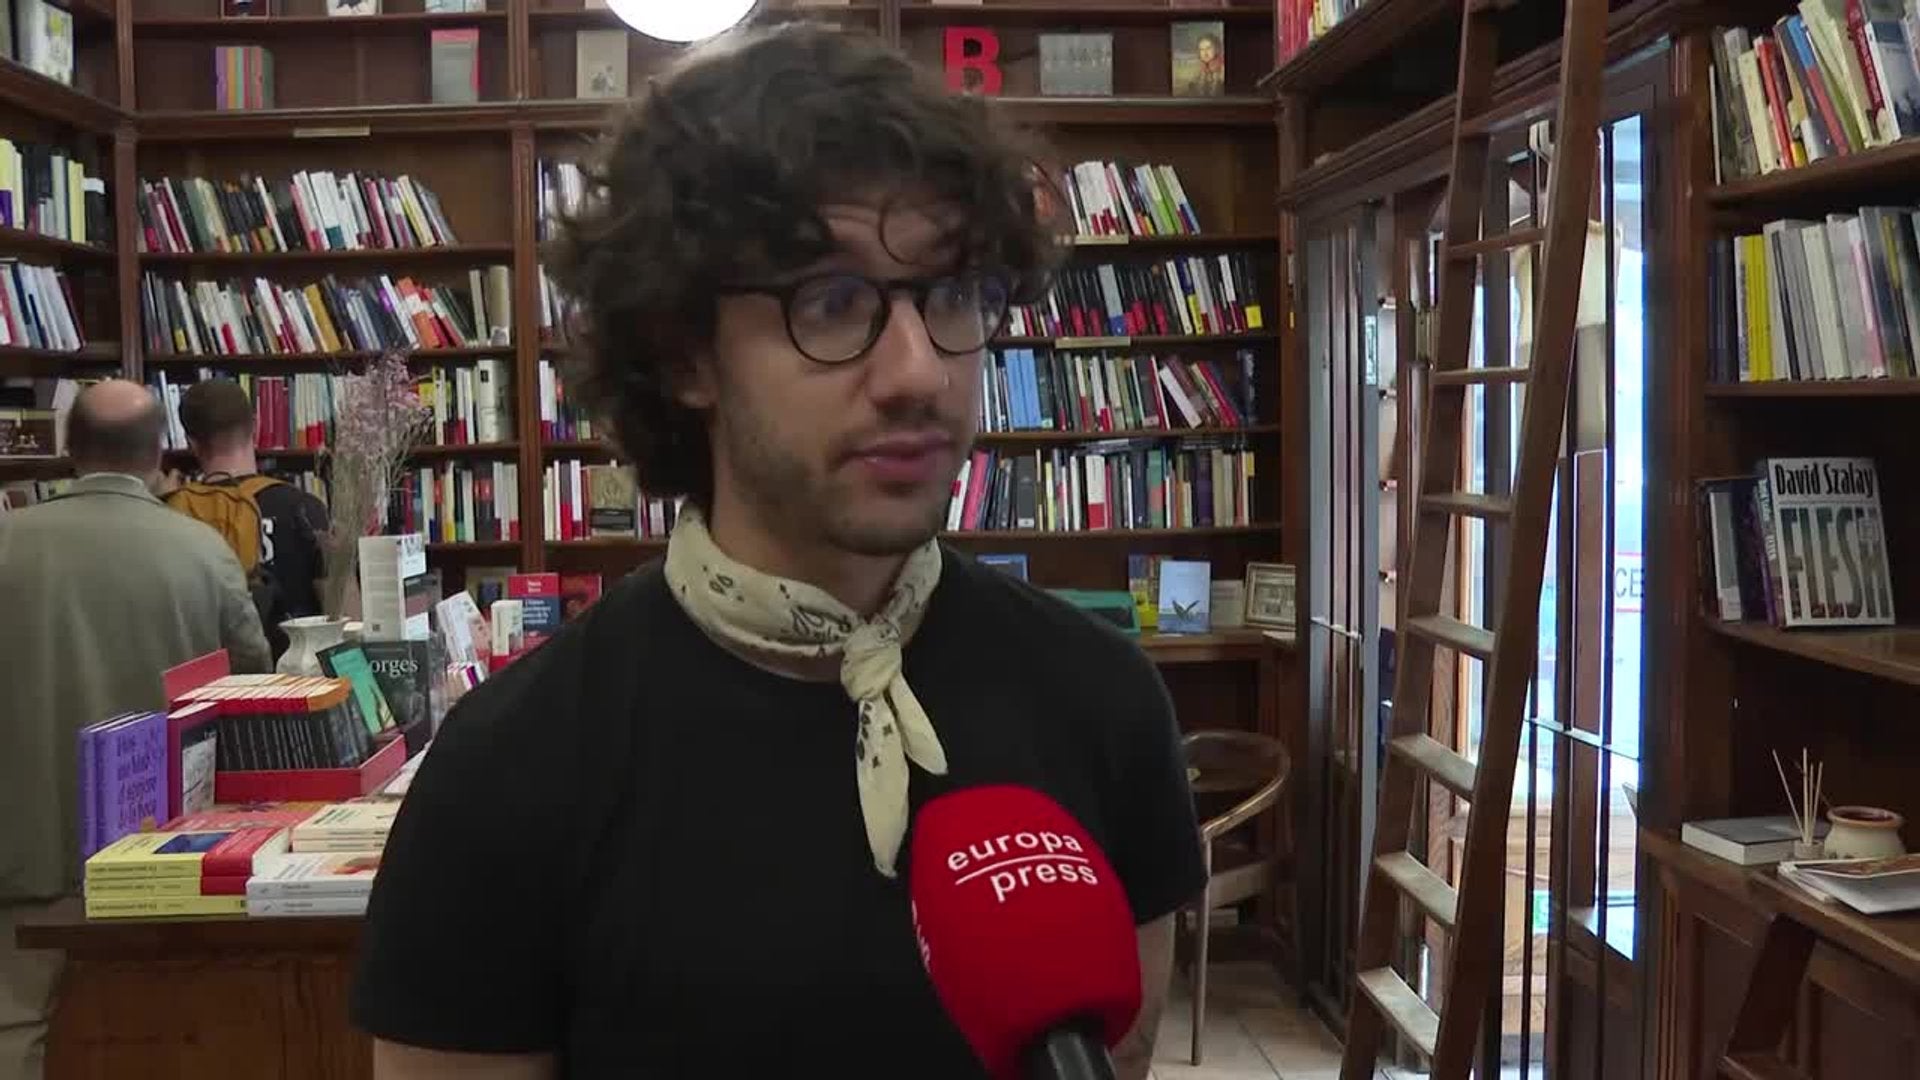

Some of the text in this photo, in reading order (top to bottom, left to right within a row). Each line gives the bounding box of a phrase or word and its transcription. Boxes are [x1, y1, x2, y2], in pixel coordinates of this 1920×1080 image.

[944, 26, 1003, 95] B
[1775, 462, 1874, 498] David Szalay
[1781, 507, 1891, 619] FLESH
[370, 658, 419, 676] orges
[948, 831, 1083, 871] europa
[991, 863, 1098, 903] press
